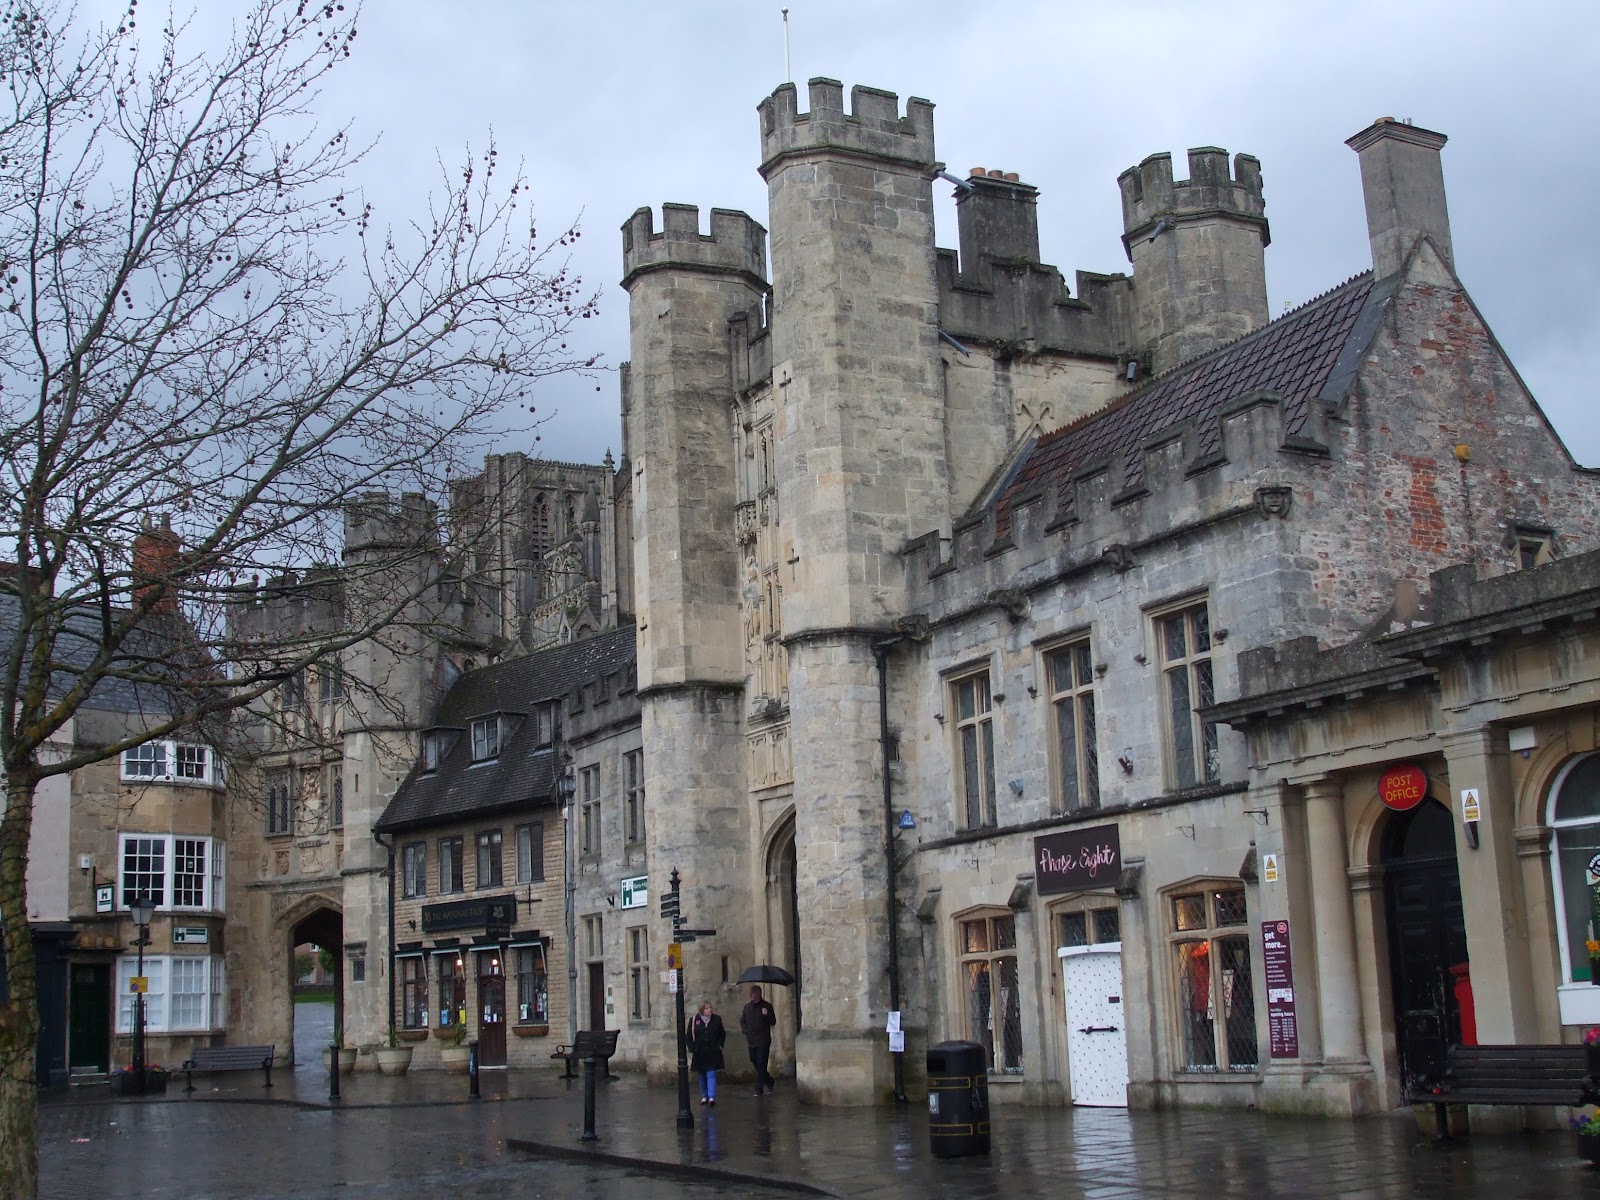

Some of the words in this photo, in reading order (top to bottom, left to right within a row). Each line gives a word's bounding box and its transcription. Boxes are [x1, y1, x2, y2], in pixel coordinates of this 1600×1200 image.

[1387, 774, 1412, 789] POST
[1385, 786, 1419, 802] OFFICE
[1040, 848, 1077, 874] Phase
[1079, 845, 1115, 878] Eight
[1264, 931, 1275, 941] get
